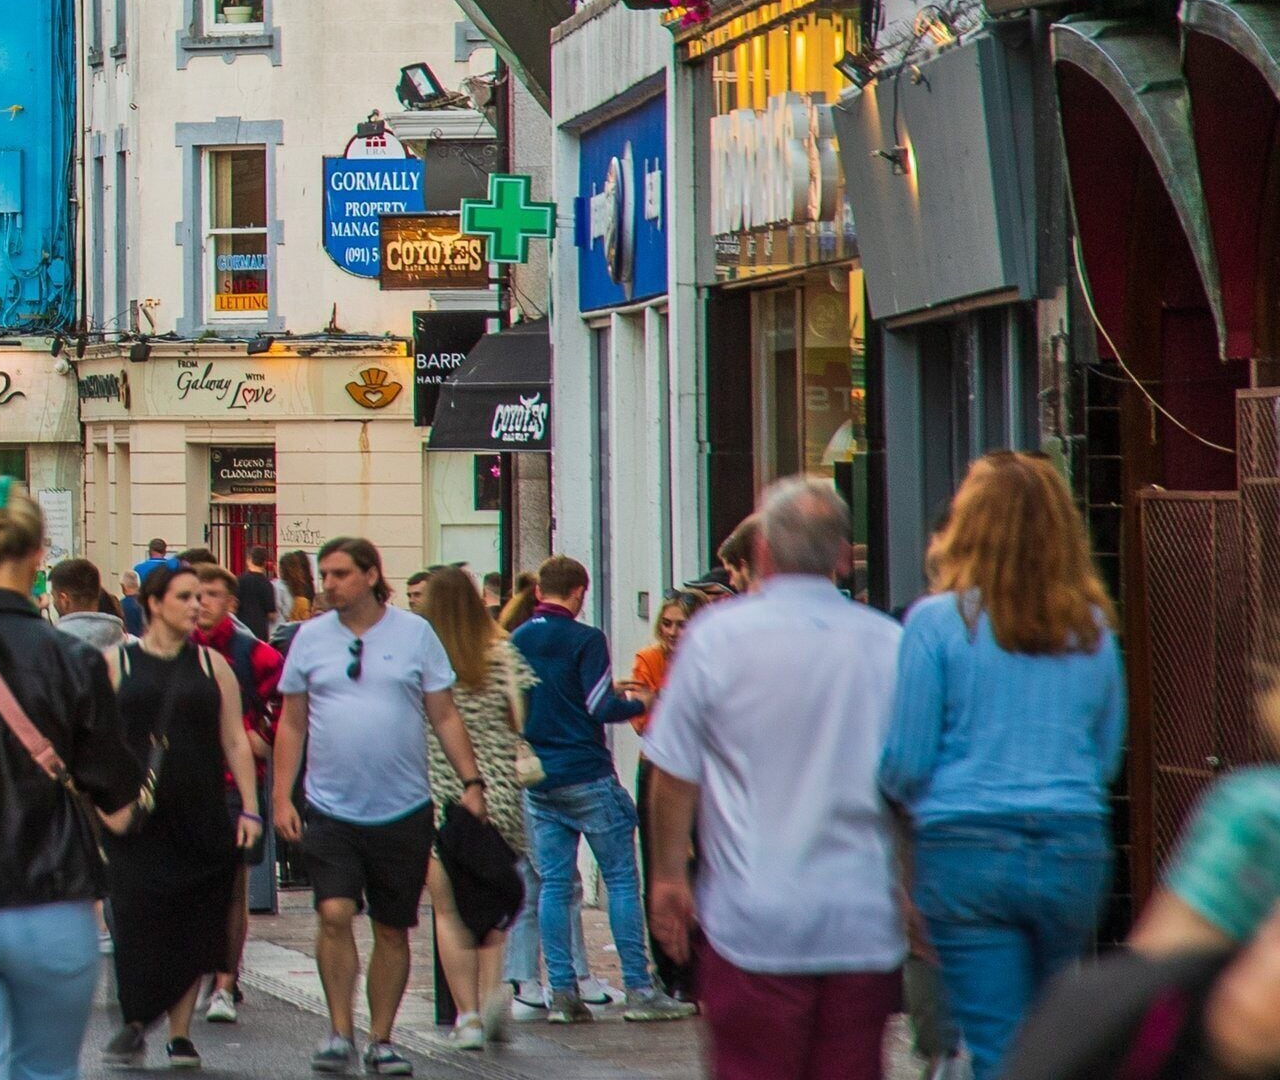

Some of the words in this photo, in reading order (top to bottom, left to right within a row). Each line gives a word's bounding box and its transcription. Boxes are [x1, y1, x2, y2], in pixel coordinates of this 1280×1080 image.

[330, 171, 420, 191] GORMALLY
[345, 201, 407, 217] PROPERTY
[331, 222, 379, 237] MANAG
[345, 247, 370, 263] (091)
[372, 248, 379, 262] 5
[386, 235, 482, 271] COYOTES
[178, 360, 198, 368] FROM
[176, 362, 232, 400] Galway
[245, 373, 266, 381] WITH
[491, 397, 548, 440] COYOTES
[233, 458, 265, 468] LEGEND
[220, 469, 263, 479] CLADDAGH
